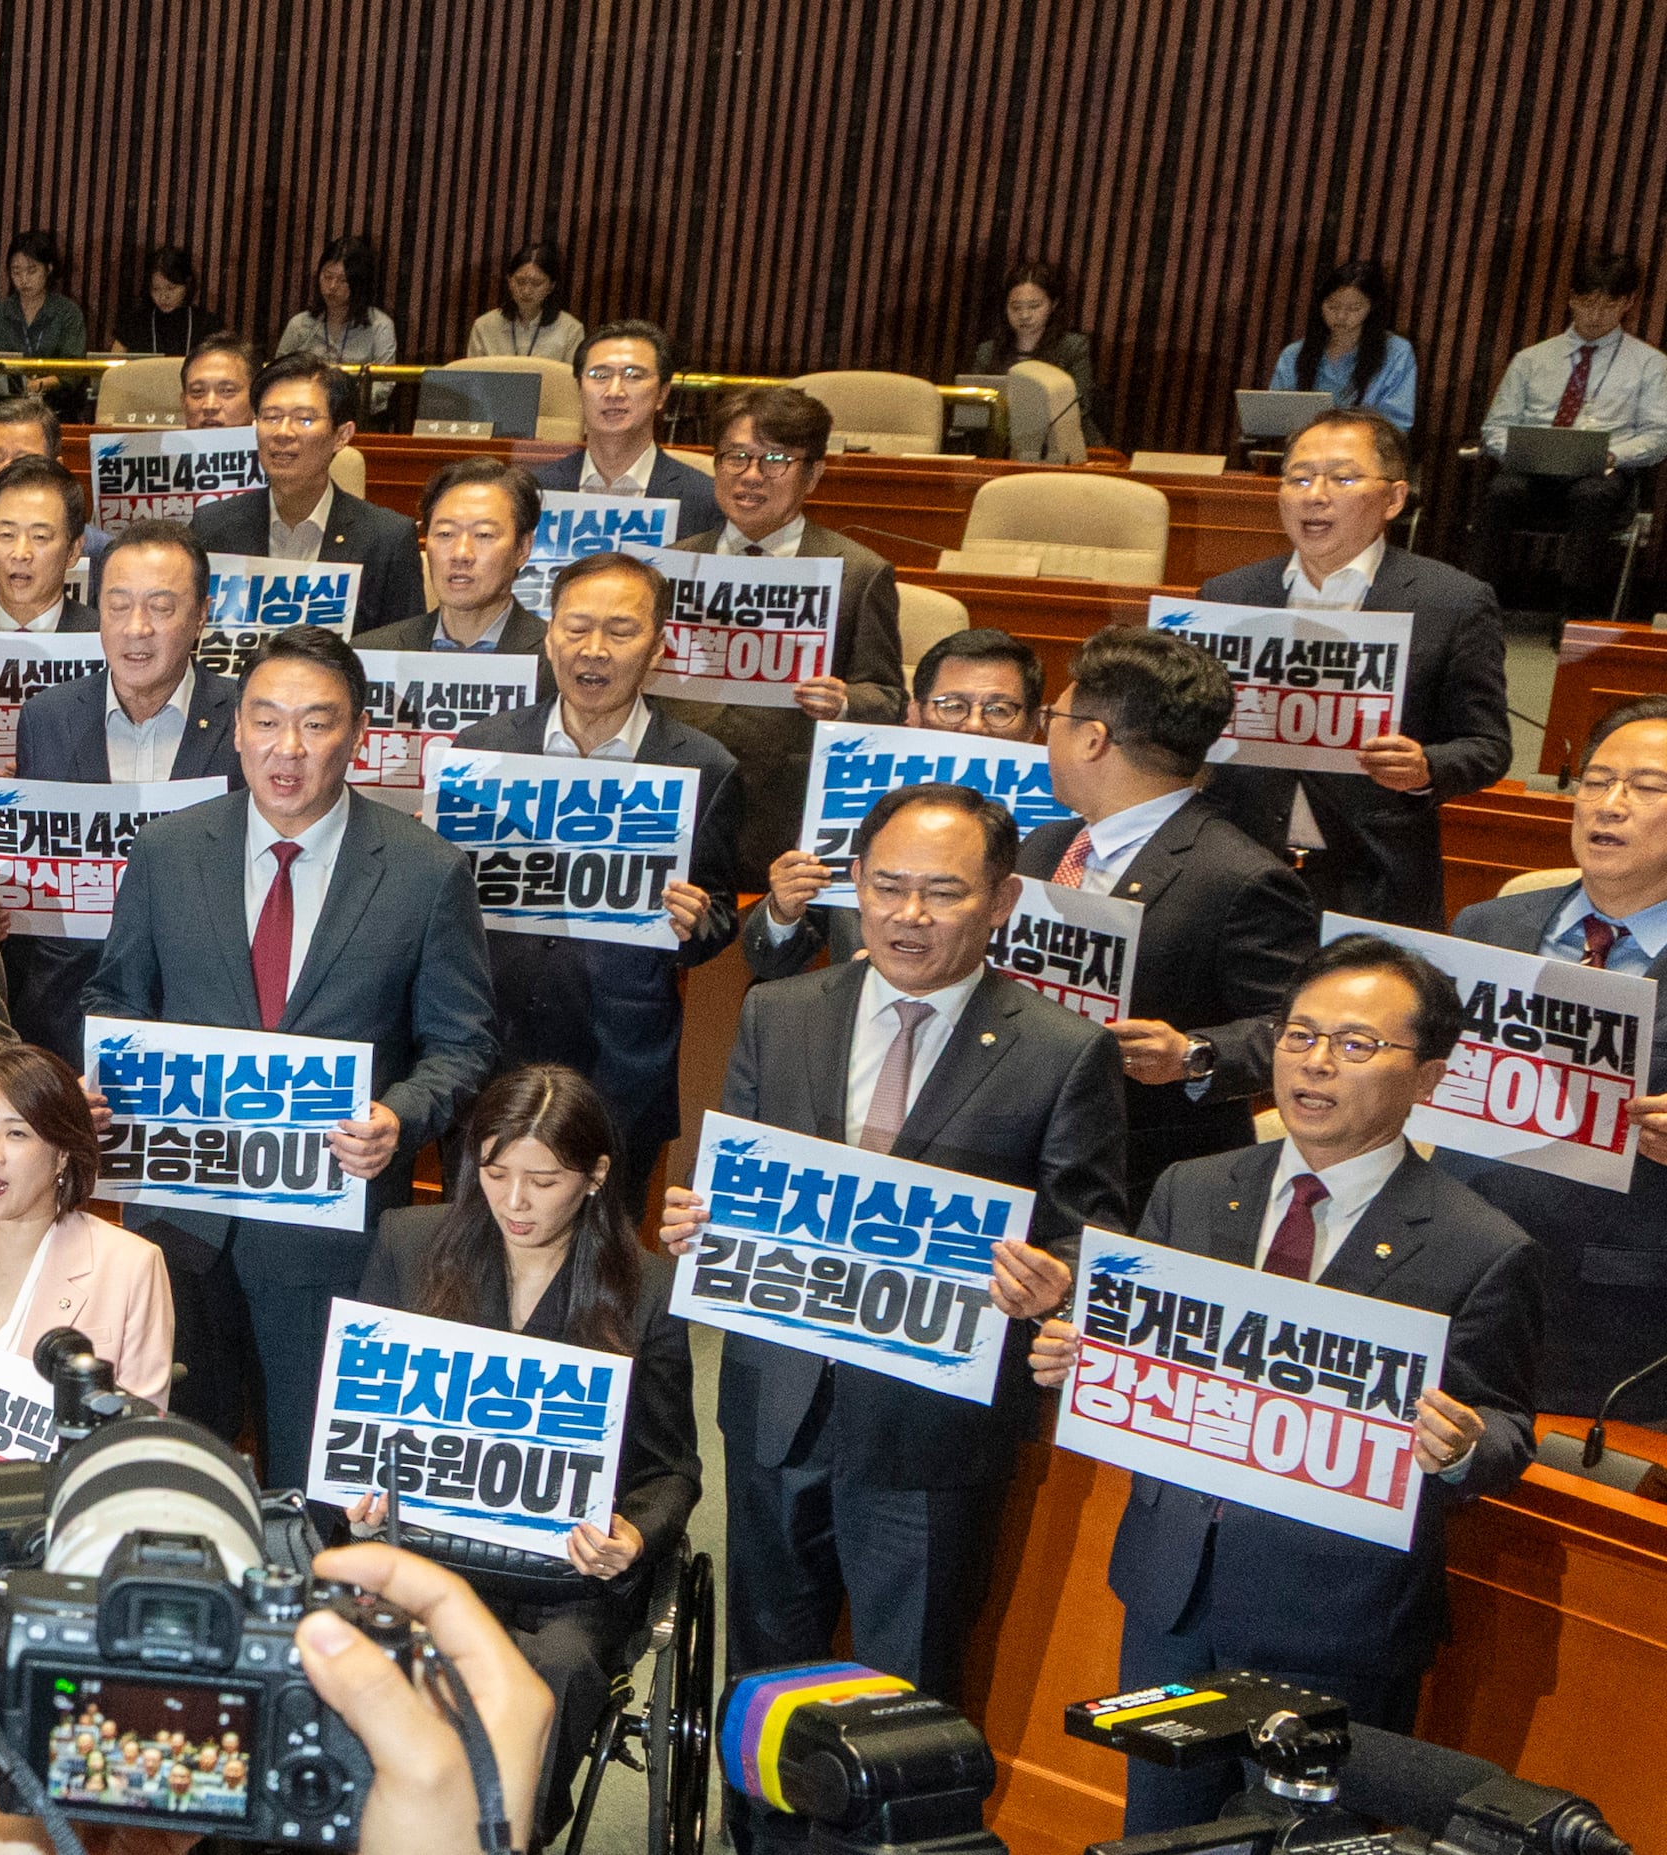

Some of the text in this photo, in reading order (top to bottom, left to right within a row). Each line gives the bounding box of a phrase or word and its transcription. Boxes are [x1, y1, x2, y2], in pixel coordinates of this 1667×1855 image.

[98, 454, 170, 494] 철거민
[535, 508, 666, 557] 치상실
[709, 583, 831, 630] 4성딱지
[667, 628, 824, 682] 철OUT
[1254, 634, 1399, 692] 4성딱지
[1234, 690, 1391, 749] 철OUT
[437, 778, 682, 844] 법치상실
[477, 853, 677, 911] 승원OUT
[1465, 980, 1638, 1075] 4성딱지
[98, 1051, 356, 1120] 법치상실
[1445, 1043, 1633, 1151] 철OUT
[97, 1122, 345, 1191] 김승원OUT
[708, 1153, 1012, 1275] 법치상실
[692, 1233, 995, 1353] 김승원OUT
[1084, 1272, 1428, 1423] 철거민 4성딱지
[334, 1339, 613, 1441] 법치상실
[1074, 1345, 1412, 1503] 강신철OUT
[323, 1419, 605, 1518] 김승원OUT
